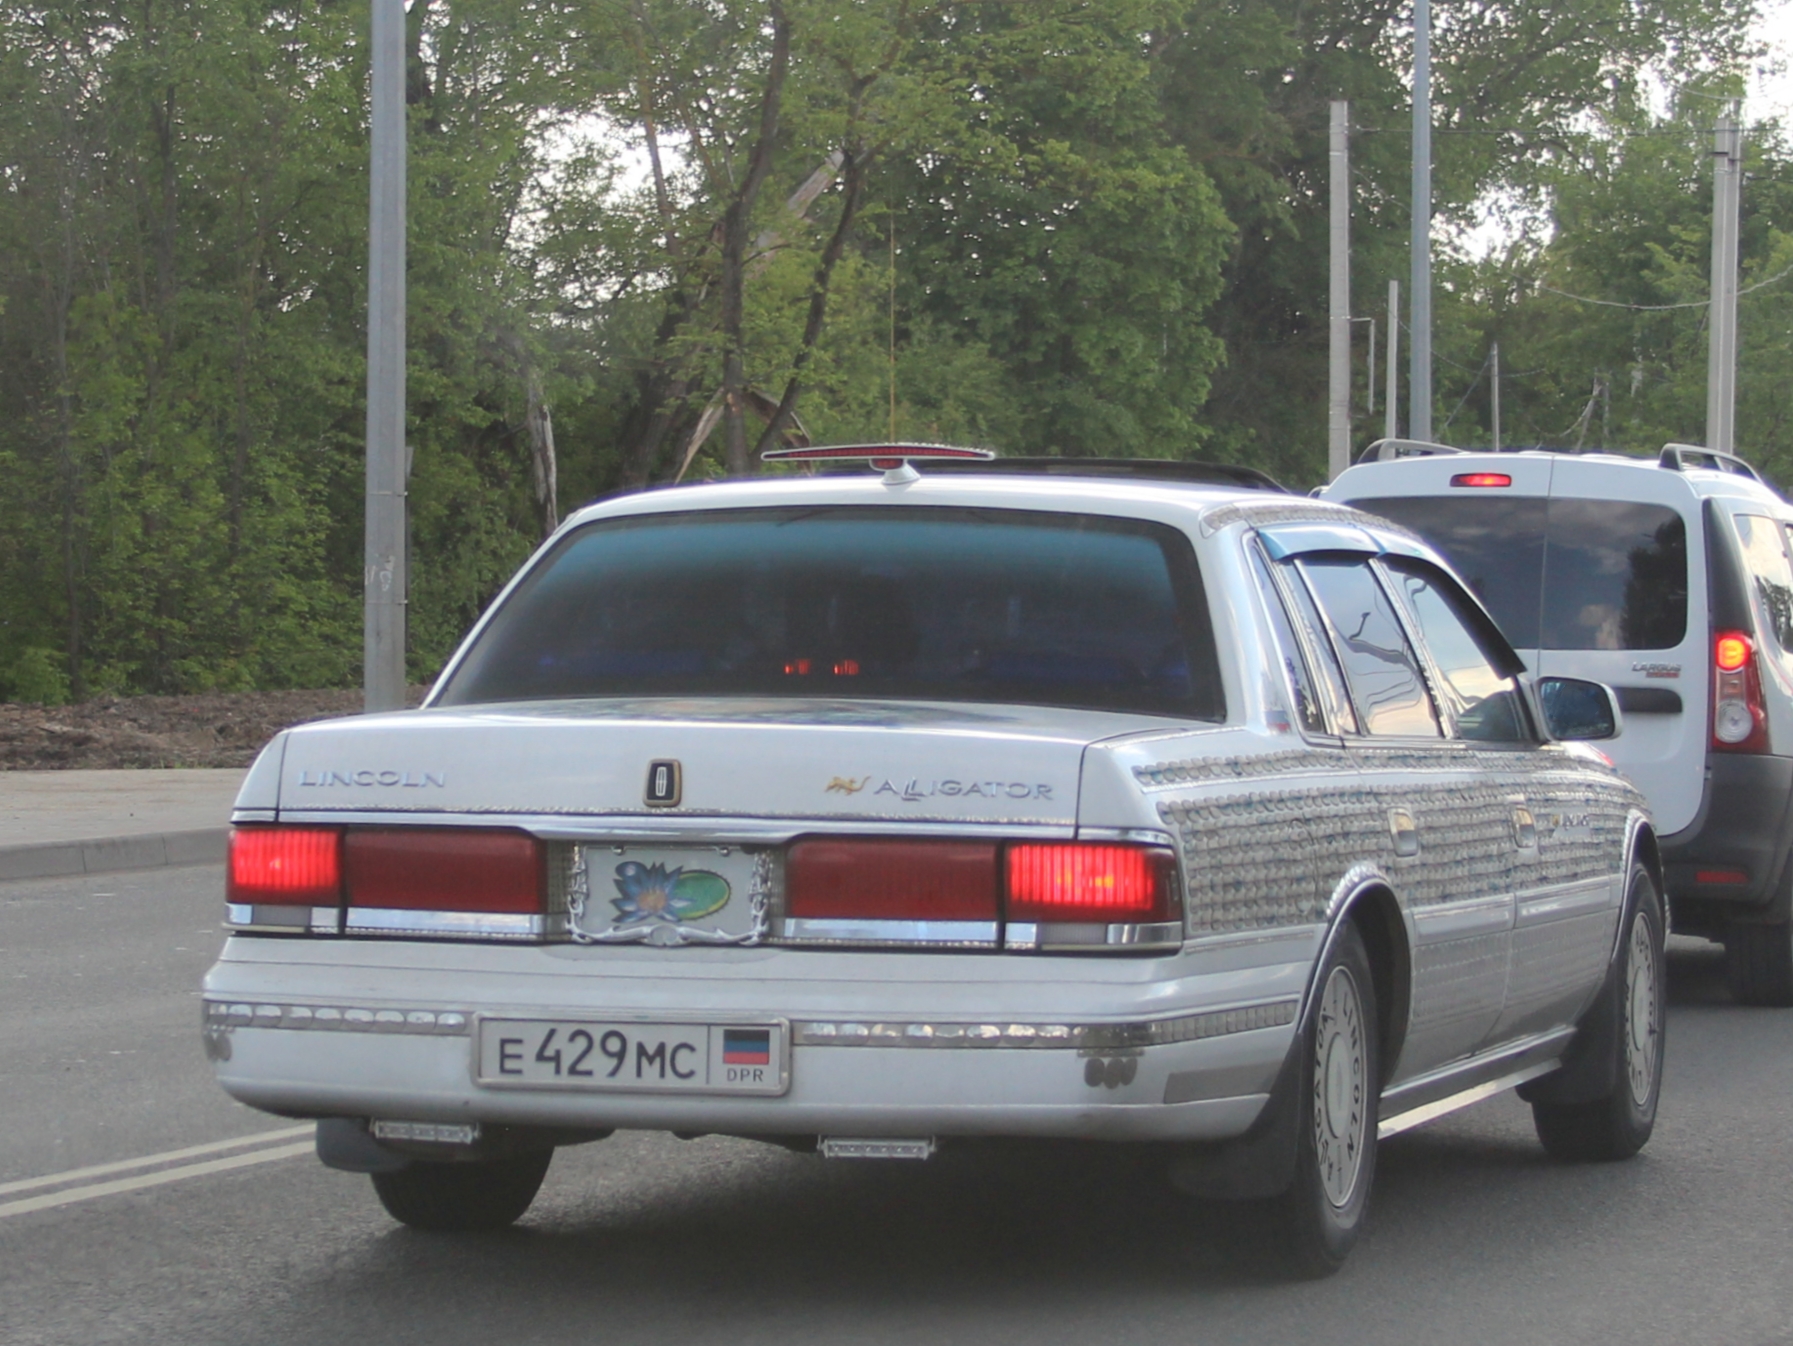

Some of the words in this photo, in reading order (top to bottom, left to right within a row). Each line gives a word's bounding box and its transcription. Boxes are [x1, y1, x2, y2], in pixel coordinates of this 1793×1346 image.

[299, 770, 445, 788] LINCOLN
[873, 776, 1055, 802] ALLIGATOR
[726, 1067, 764, 1082] DPR
[1343, 992, 1360, 1161] LINCOLN
